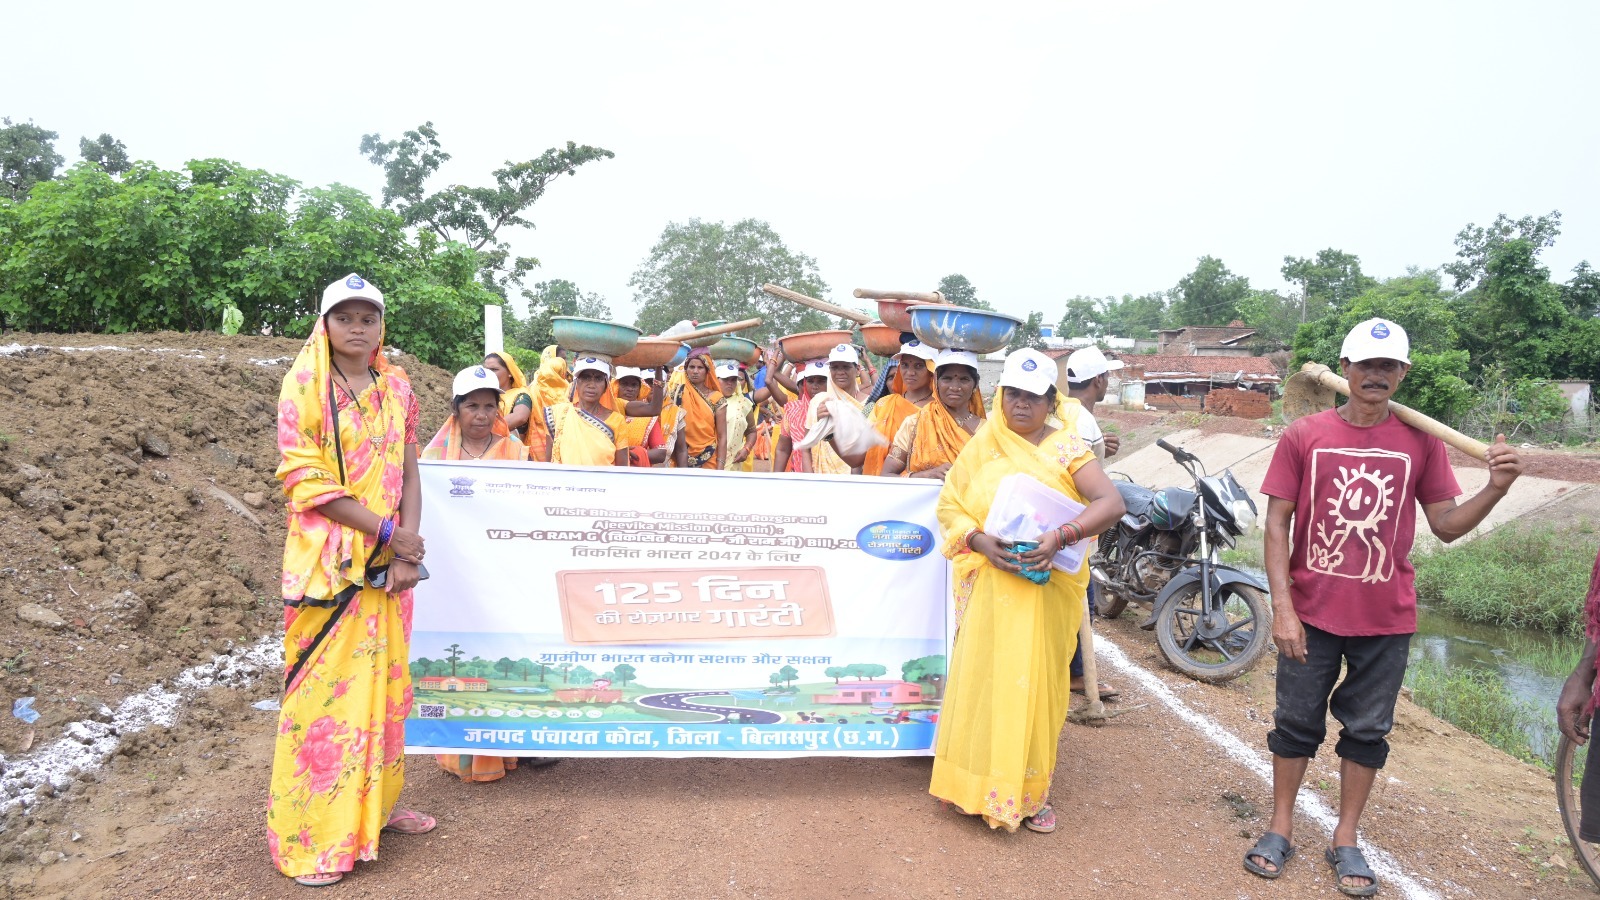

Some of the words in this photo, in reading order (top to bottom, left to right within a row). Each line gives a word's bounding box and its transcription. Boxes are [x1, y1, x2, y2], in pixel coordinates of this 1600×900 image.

[545, 507, 587, 517] Viksit
[589, 508, 638, 518] Bharat
[653, 511, 727, 522] Guarantee
[729, 513, 749, 522] for
[750, 514, 798, 525] Rozgar
[799, 515, 827, 525] and
[593, 520, 655, 531] Ajeevika
[657, 522, 711, 532] Mission
[546, 530, 585, 541] RAM
[586, 531, 599, 541] G
[600, 530, 668, 543] (विकसित
[669, 533, 709, 544] भारत
[726, 533, 747, 545] जी
[748, 536, 776, 546] राम
[806, 538, 838, 549] Bill,
[571, 545, 642, 558] विकसित
[646, 548, 693, 560] भारत
[697, 550, 742, 561] 2047
[746, 549, 764, 562] के
[768, 550, 802, 563] लिए
[594, 580, 683, 605] 125
[691, 575, 790, 603] दिन
[594, 611, 622, 625] की
[705, 602, 806, 628] गारंटी
[540, 651, 597, 663] ग्रामीण
[601, 653, 646, 663] भारत
[648, 652, 695, 664] बनेगा
[697, 654, 748, 664] सशक्त
[751, 652, 783, 665] और
[785, 655, 833, 665] सक्षम
[463, 728, 527, 744] जनपद
[530, 726, 600, 745] पंचायत
[667, 726, 722, 746] जिला
[740, 726, 830, 751] बिलासपुर
